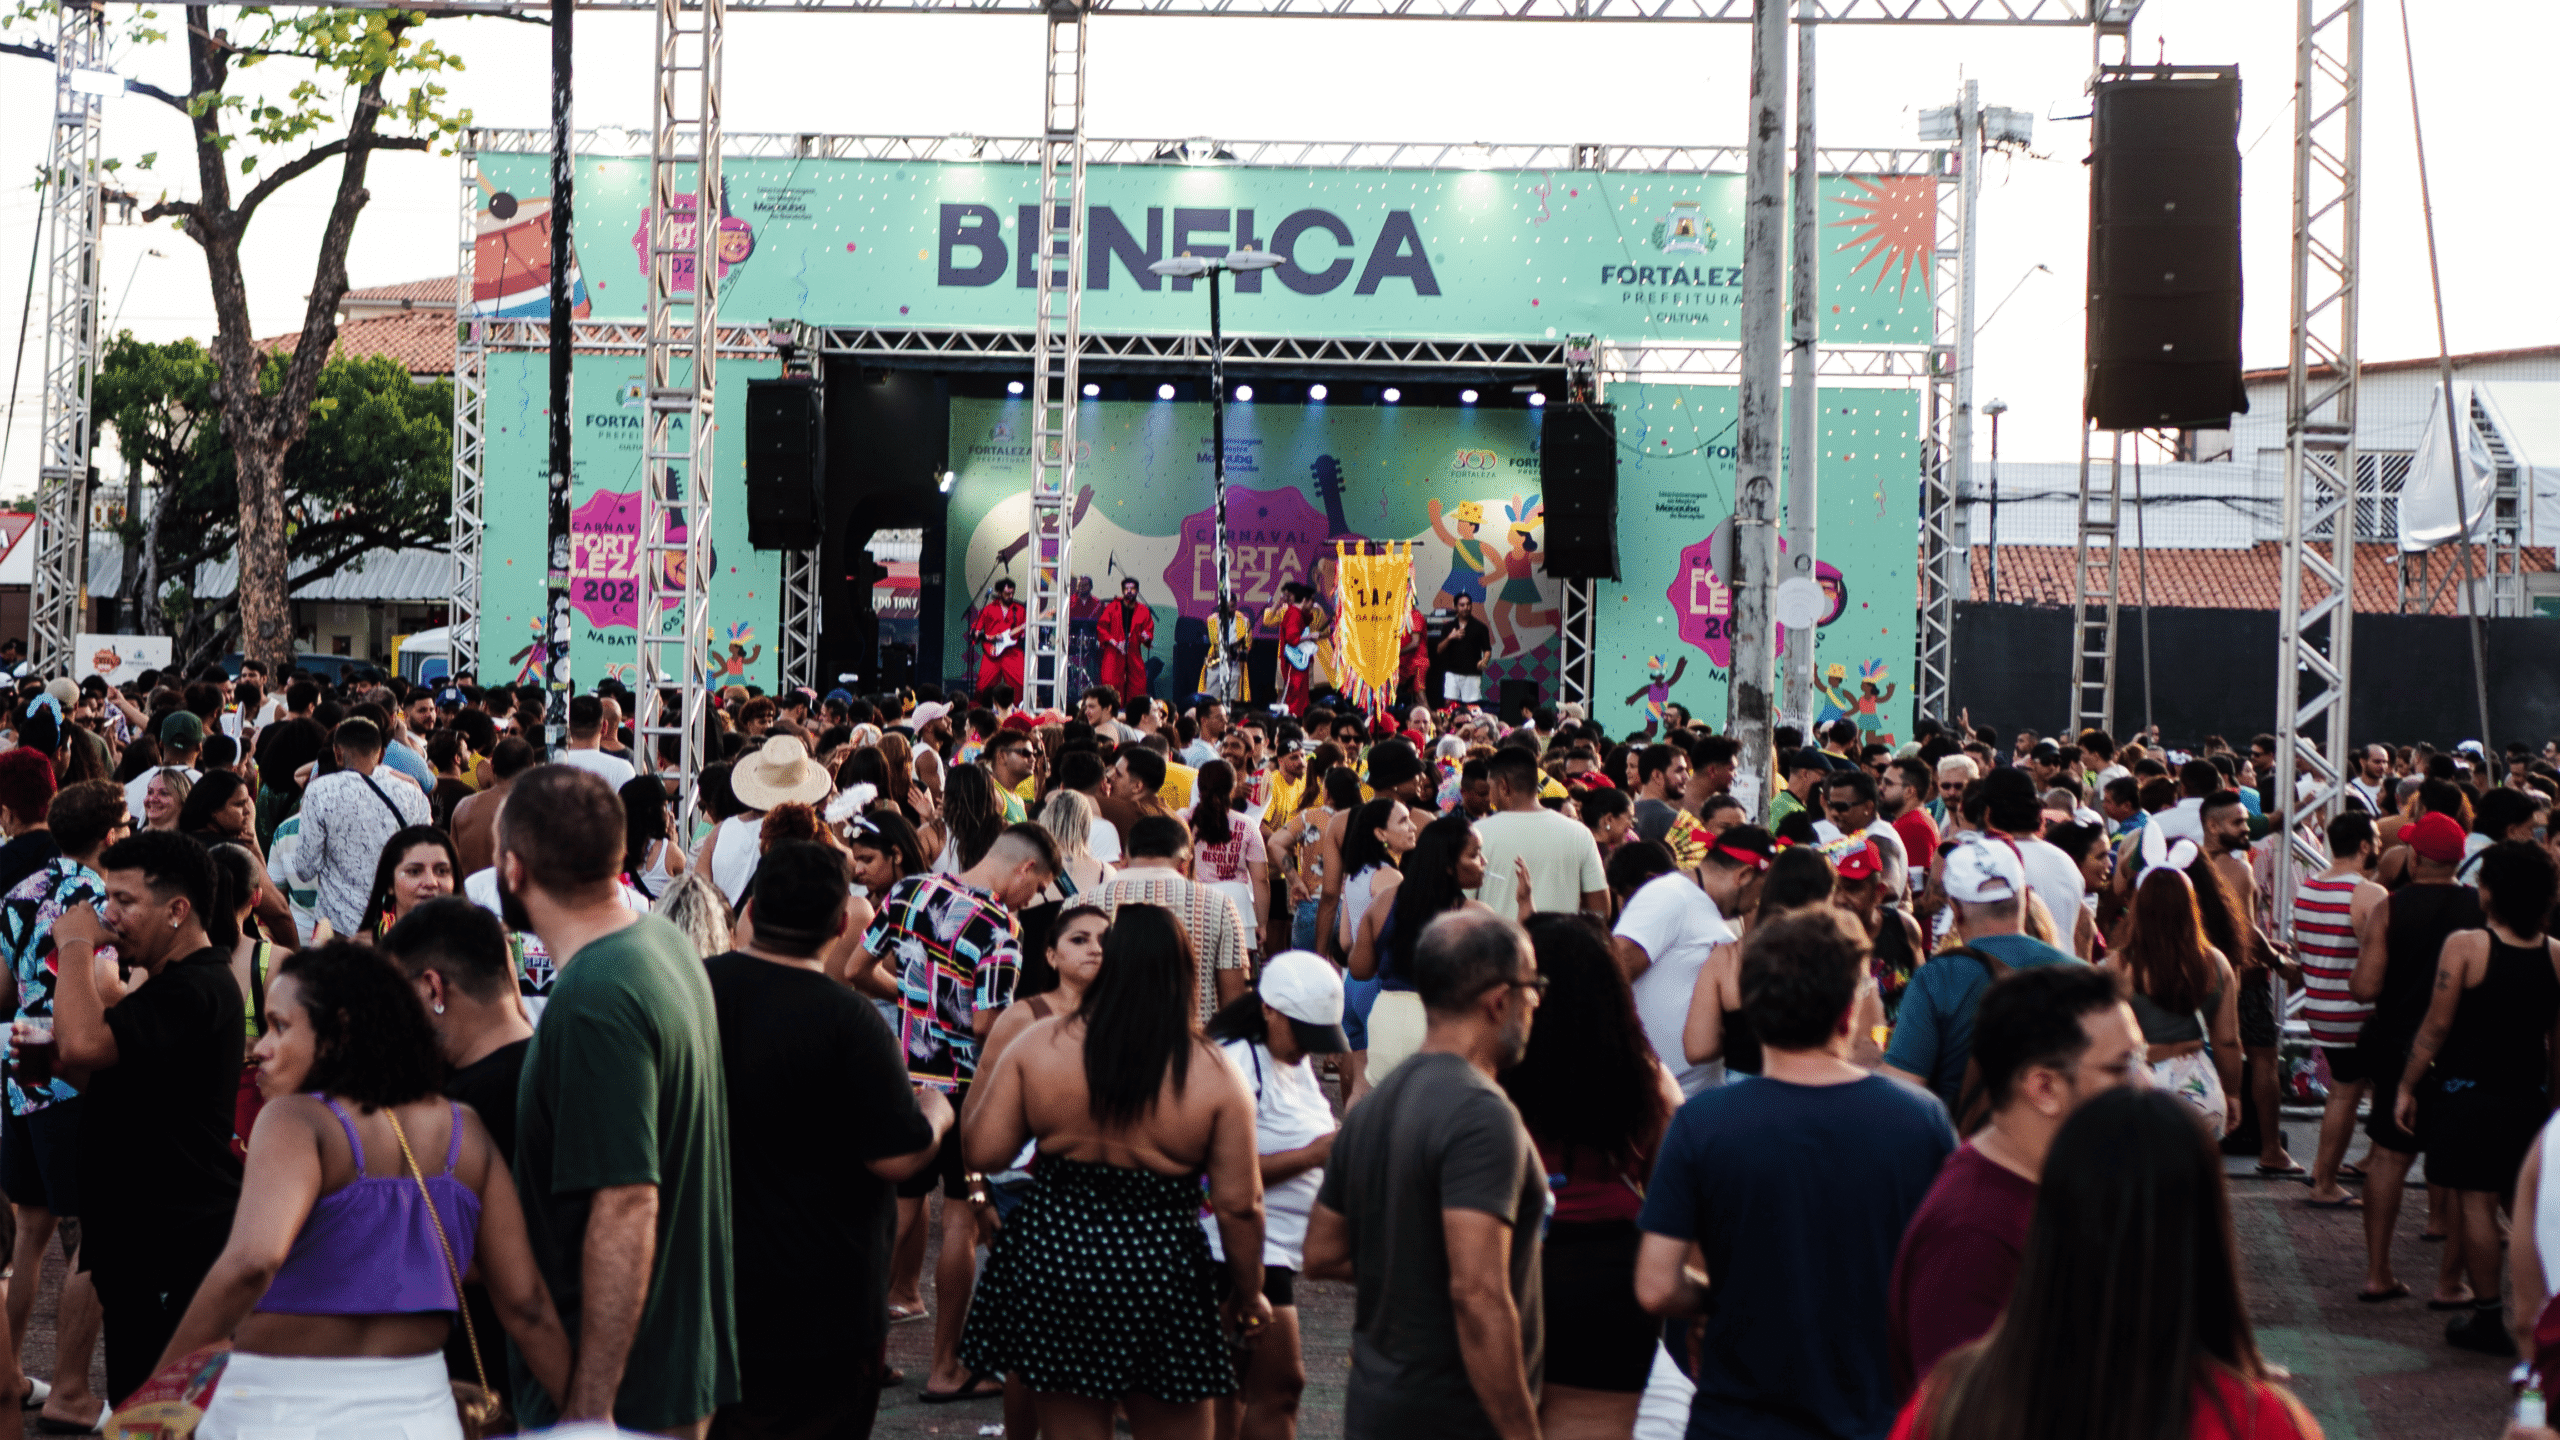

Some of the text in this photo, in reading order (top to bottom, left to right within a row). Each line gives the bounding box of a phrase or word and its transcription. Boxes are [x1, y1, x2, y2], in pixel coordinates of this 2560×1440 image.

[937, 203, 1442, 296] BENFICA
[1601, 265, 1743, 287] FORTALEZ
[1656, 312, 1709, 323] CULTURA
[1195, 544, 1301, 571] FORTA
[583, 580, 639, 602] 202
[1708, 668, 1727, 683] NA
[1202, 851, 1240, 863] RESOLVO
